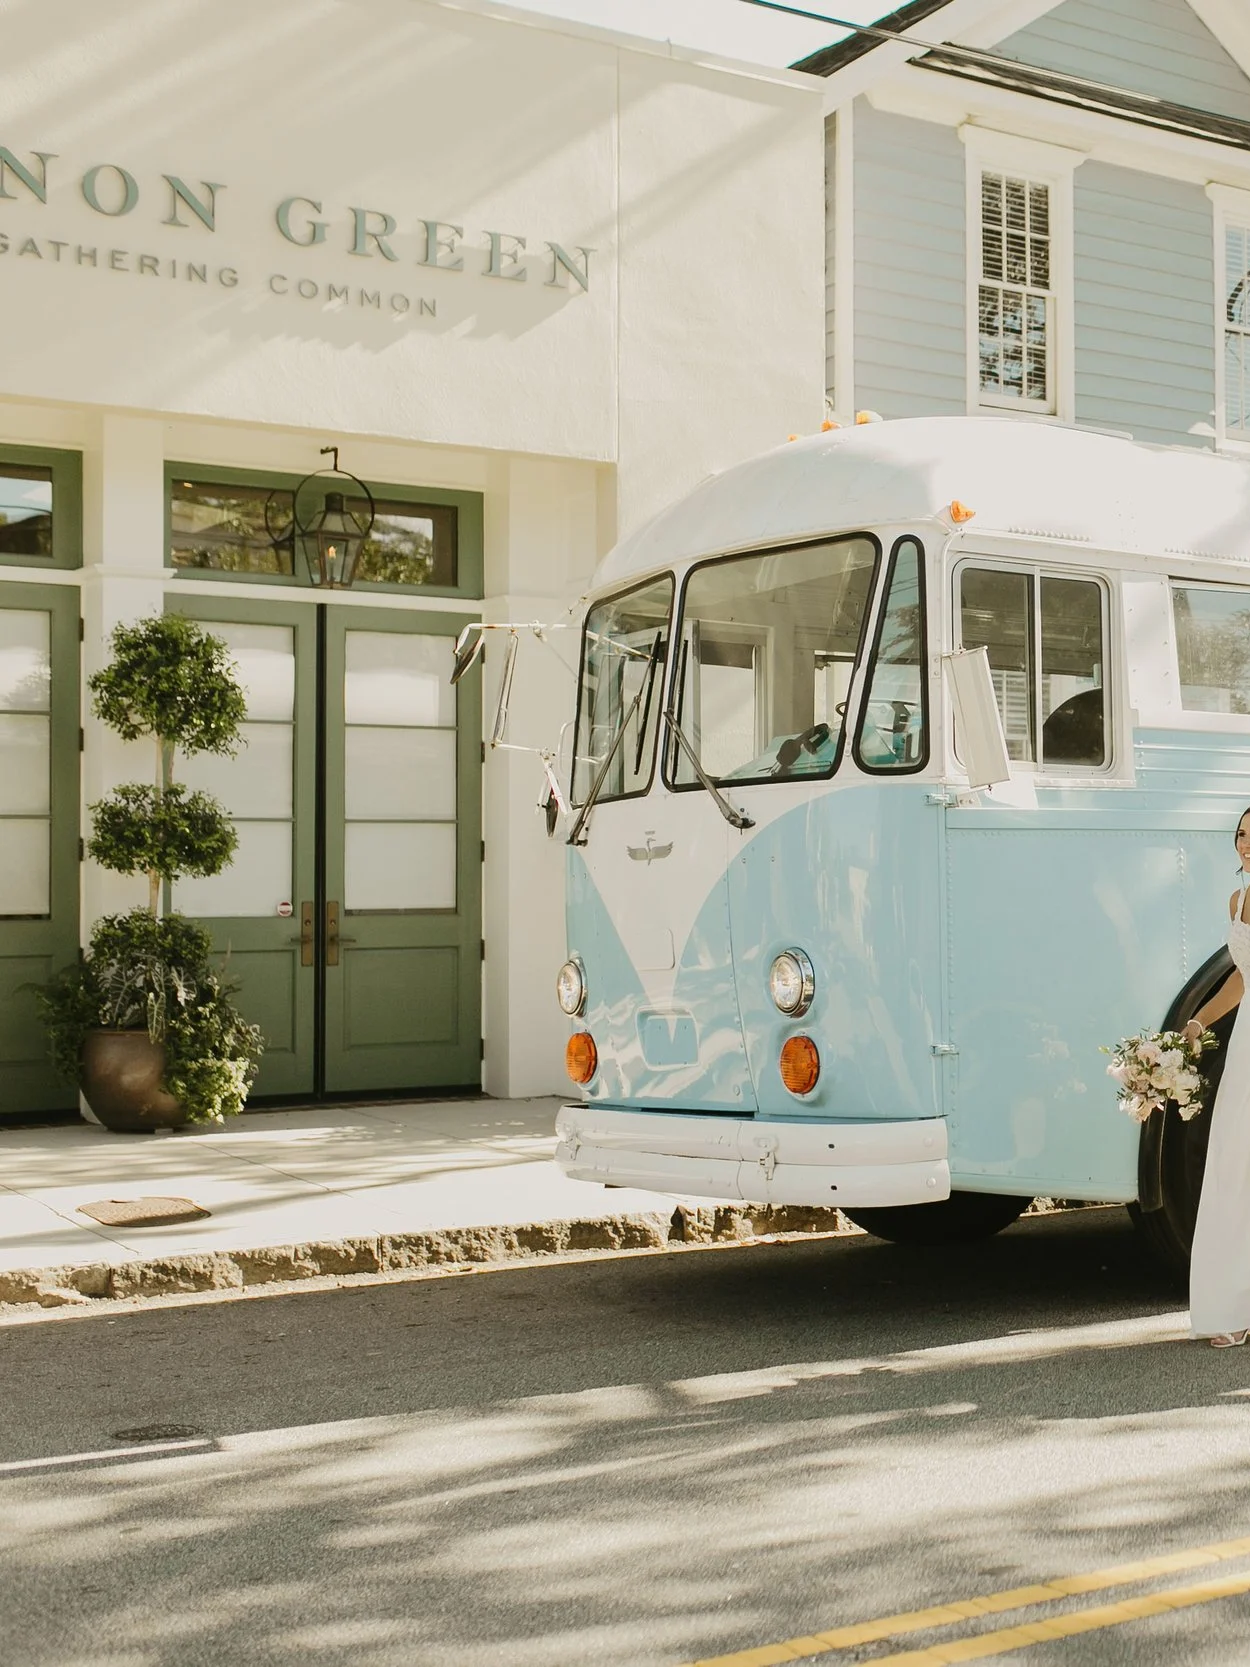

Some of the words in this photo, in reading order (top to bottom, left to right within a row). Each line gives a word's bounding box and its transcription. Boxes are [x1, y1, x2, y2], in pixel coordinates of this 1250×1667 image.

[0, 146, 227, 233] NON
[275, 196, 598, 294] GREEN
[269, 273, 438, 318] COMMON
